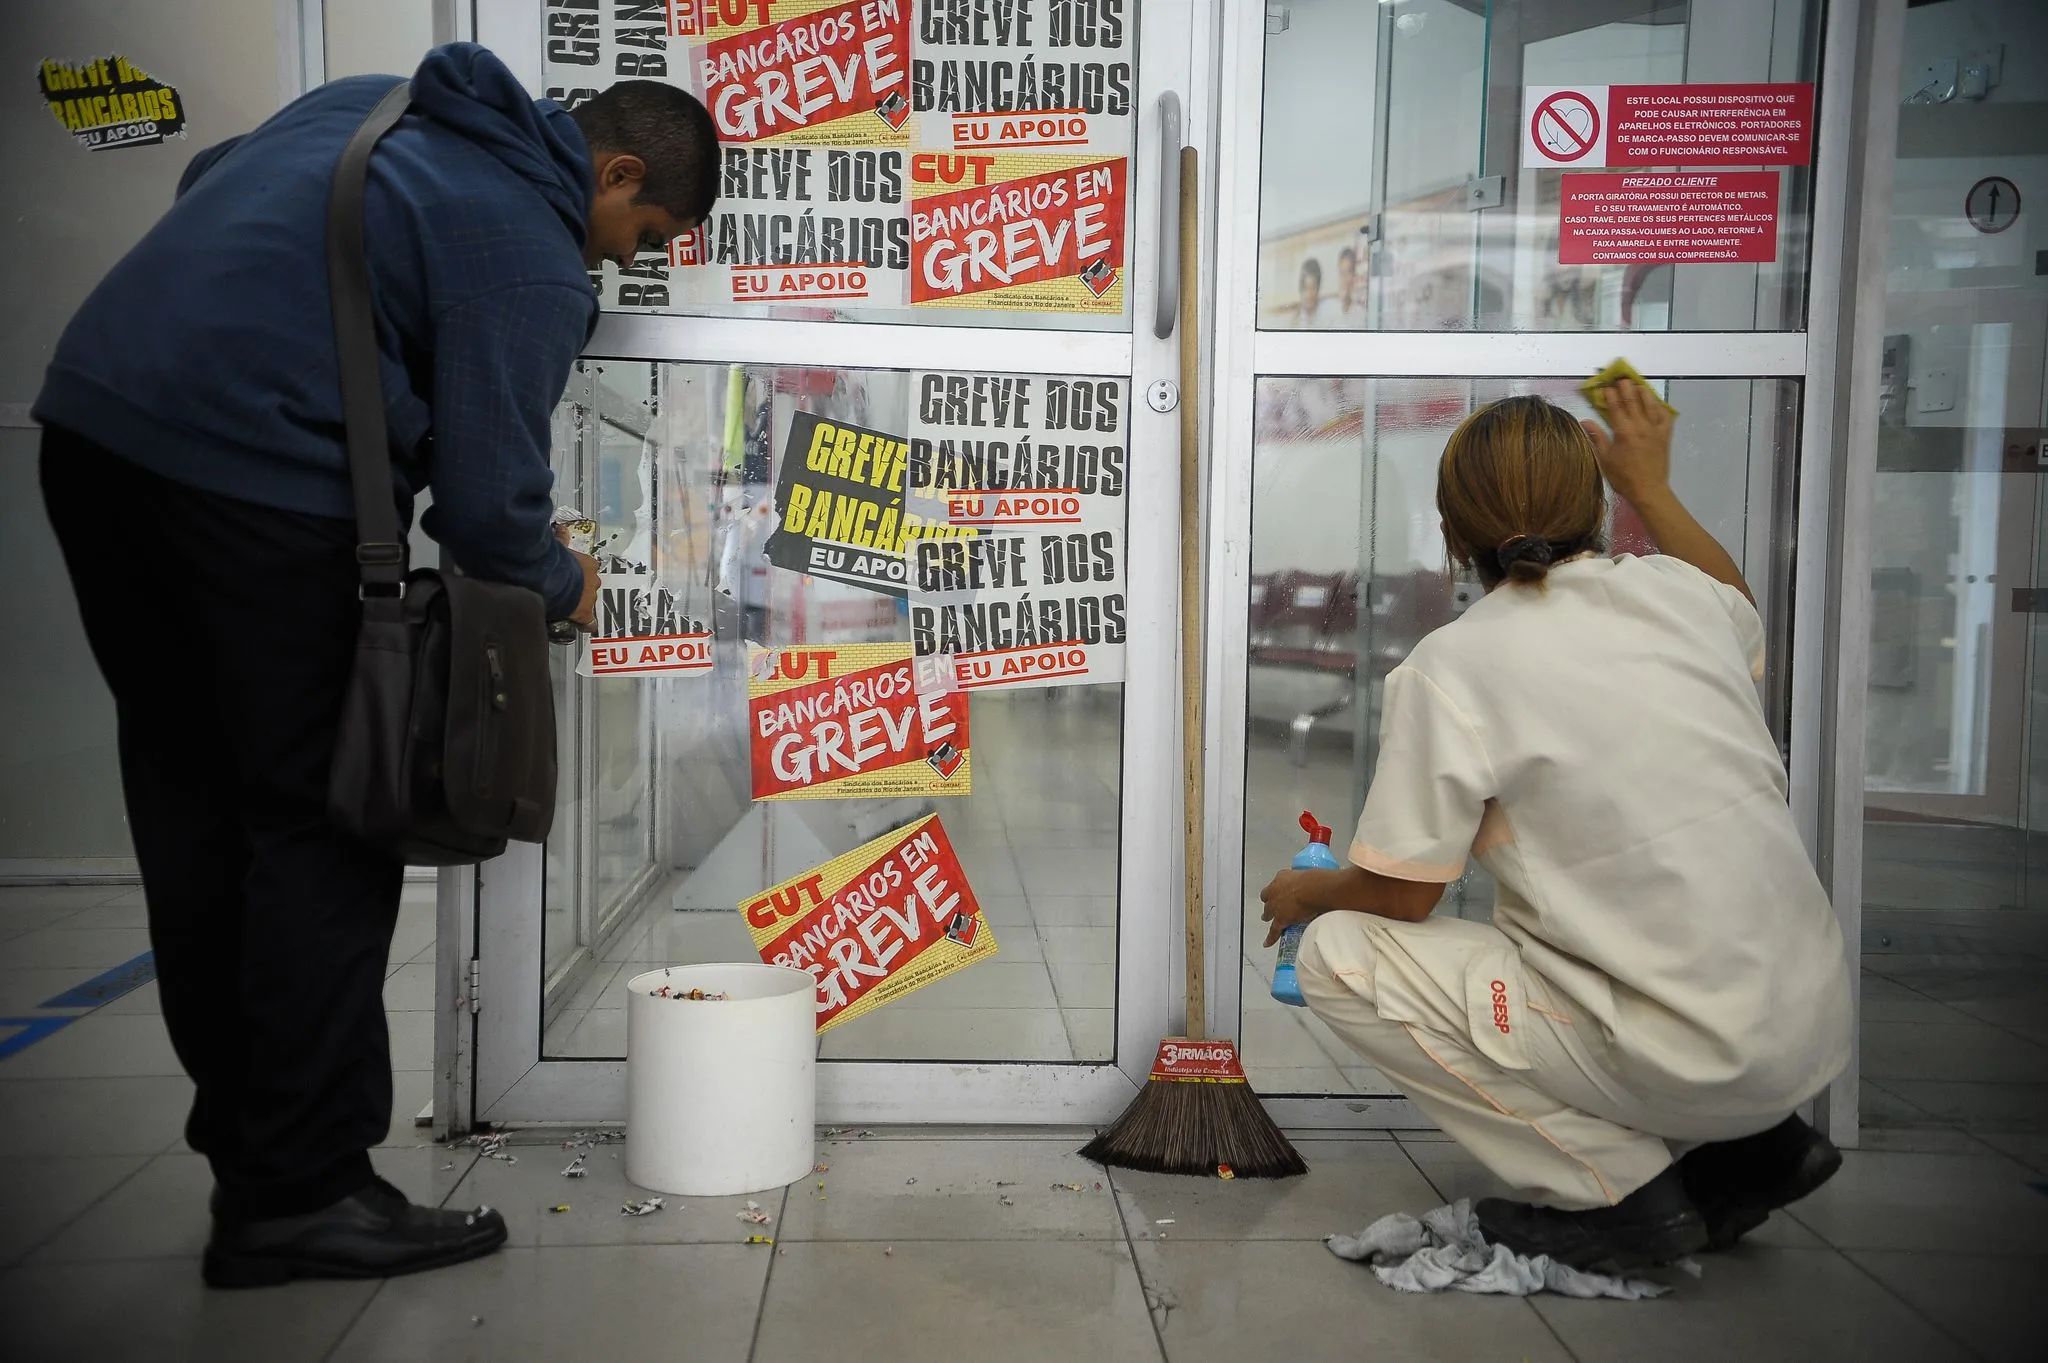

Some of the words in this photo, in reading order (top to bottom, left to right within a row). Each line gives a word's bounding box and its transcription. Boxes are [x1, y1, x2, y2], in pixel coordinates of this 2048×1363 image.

[921, 0, 1033, 47] GREVE
[1049, 0, 1123, 49] DOS
[699, 12, 856, 89] BANCÁRIOS
[861, 0, 900, 33] EM
[715, 34, 904, 138] GREVE
[912, 54, 1130, 116] BANCÁRIOS
[1626, 96, 1650, 105] ESTE
[1651, 96, 1682, 105] LOCAL
[1683, 95, 1716, 104] POSSUI
[1718, 95, 1774, 104] DISPOSITIVO
[1776, 95, 1796, 103] QUE
[49, 87, 177, 132] BANCÁRIOS
[1634, 110, 1659, 118] PODE
[1661, 109, 1699, 118] CAUSAR
[1700, 108, 1771, 117] INTERFERÊNCIA
[1772, 109, 1786, 117] EM
[106, 121, 158, 142] APOIO
[953, 123, 990, 142] EU
[1000, 118, 1087, 140] APOIO
[1618, 122, 1672, 130] APARELHOS
[1674, 120, 1738, 130] ELETRÔNICOS.
[1741, 120, 1801, 129] PORTADORES
[1618, 135, 1630, 143] DE
[1632, 135, 1696, 143] MARCA-PASSO
[1698, 134, 1729, 142] DEVEM
[1731, 133, 1800, 142] COMUNICAR-SE
[1628, 147, 1649, 155] COM
[1650, 147, 1658, 155] O
[1660, 145, 1720, 155] FUNCIONÁRIO
[1722, 145, 1788, 155] RESPONSÁVEL
[719, 147, 811, 201] REVE
[828, 150, 902, 204] DOS
[912, 153, 995, 186] CUT
[1622, 177, 1672, 187] PREZADO
[1674, 176, 1717, 187] CLIENTE
[912, 185, 1069, 243] BANCÁRIOS
[1075, 166, 1113, 201] EM
[1570, 193, 1577, 201] A
[1578, 193, 1604, 201] PORTA
[1605, 191, 1648, 200] GIRATÓRIA
[1649, 192, 1679, 200] POSSUI
[1680, 192, 1723, 200] DETECTOR
[1627, 204, 1680, 212] TRAVAMENTO
[1682, 203, 1688, 211] É
[1688, 203, 1743, 211] AUTOMÁTICO.
[1573, 228, 1584, 236] NA
[1585, 228, 1610, 236] CAIXA
[1678, 227, 1691, 235] AO
[1717, 226, 1756, 234] RETORNE
[1757, 225, 1764, 234] À
[1589, 216, 1616, 224] TRAVE,
[1617, 215, 1641, 223] DEIXE
[1642, 215, 1654, 223] OS
[1655, 215, 1677, 223] SEUS
[1678, 214, 1726, 222] PERTENCES
[1727, 213, 1773, 221] METÁLICOS
[922, 203, 1112, 293] GREVE
[1592, 252, 1637, 260] CONTAMOS
[1658, 251, 1675, 259] SUA
[1676, 249, 1739, 259] COMPREENSÃO.
[1656, 239, 1662, 247] E
[1691, 238, 1742, 246] NOVAMENTE.
[732, 275, 768, 294] EU
[779, 271, 867, 292] APOIO
[920, 374, 1031, 428] GREVE
[1045, 380, 1119, 432] DOS
[806, 422, 910, 493] GREVE
[910, 435, 1124, 496] BANCÁRIOS
[949, 499, 984, 517] EU
[994, 498, 1081, 516] APOIO
[809, 547, 845, 569] EU
[917, 537, 1027, 593] GREVE
[1041, 531, 1115, 585] DOS
[912, 592, 1126, 656] BANCÁRIOS
[592, 647, 628, 666] EU
[766, 651, 837, 680] UT
[956, 661, 992, 682] EU
[1002, 650, 1086, 676] APOIO
[758, 667, 912, 738] BANCÁRIOS
[918, 655, 955, 688] EM
[771, 688, 956, 784] GREVE
[747, 874, 824, 929] CUT
[773, 860, 902, 968] BANCÁRIOS
[900, 831, 939, 873] EM
[1490, 980, 1510, 1034] OSESP
[1160, 1044, 1178, 1066] 3
[1177, 1045, 1233, 1061] IRMÃOS
